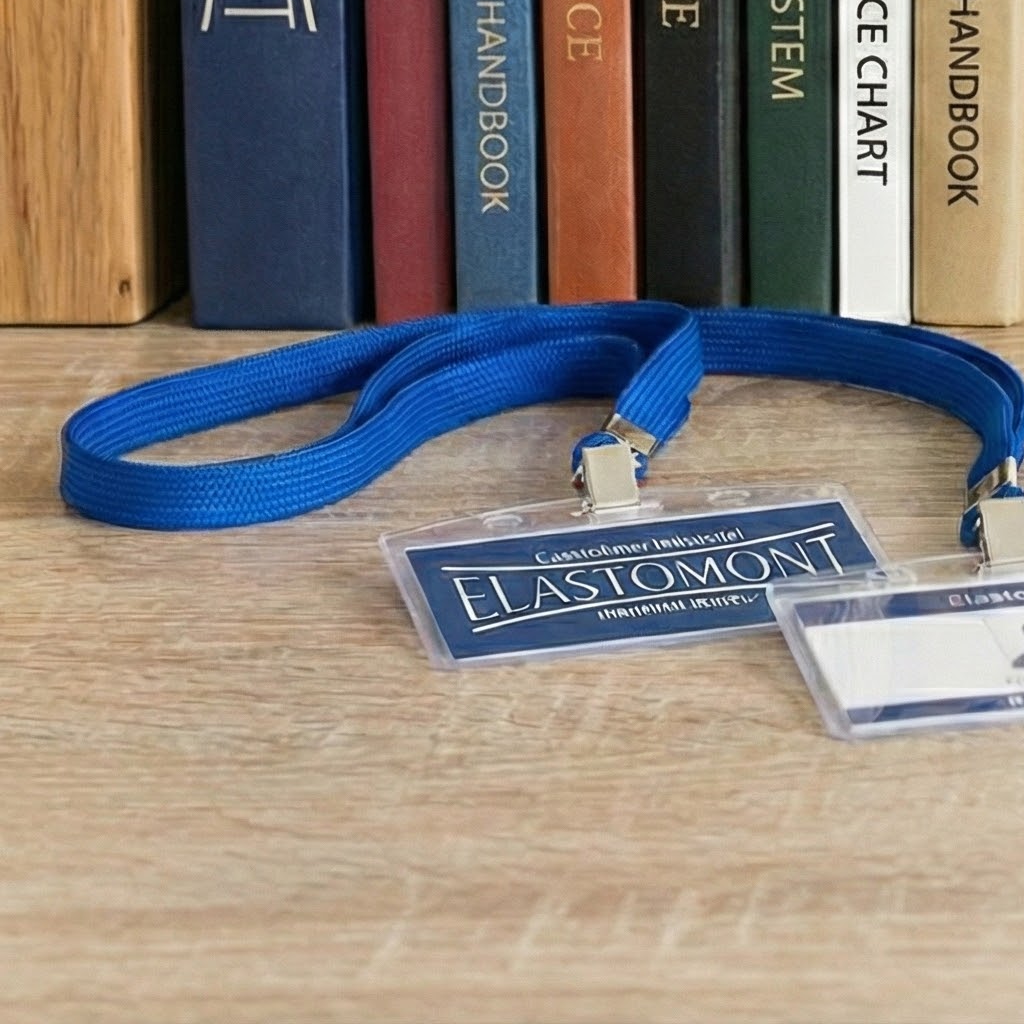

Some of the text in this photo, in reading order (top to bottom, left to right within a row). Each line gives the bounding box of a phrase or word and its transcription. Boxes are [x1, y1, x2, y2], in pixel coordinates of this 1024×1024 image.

[476, 1, 510, 214] HANDBOOK
[856, 55, 888, 186] CHART
[452, 532, 843, 622] ELASTOMONT
